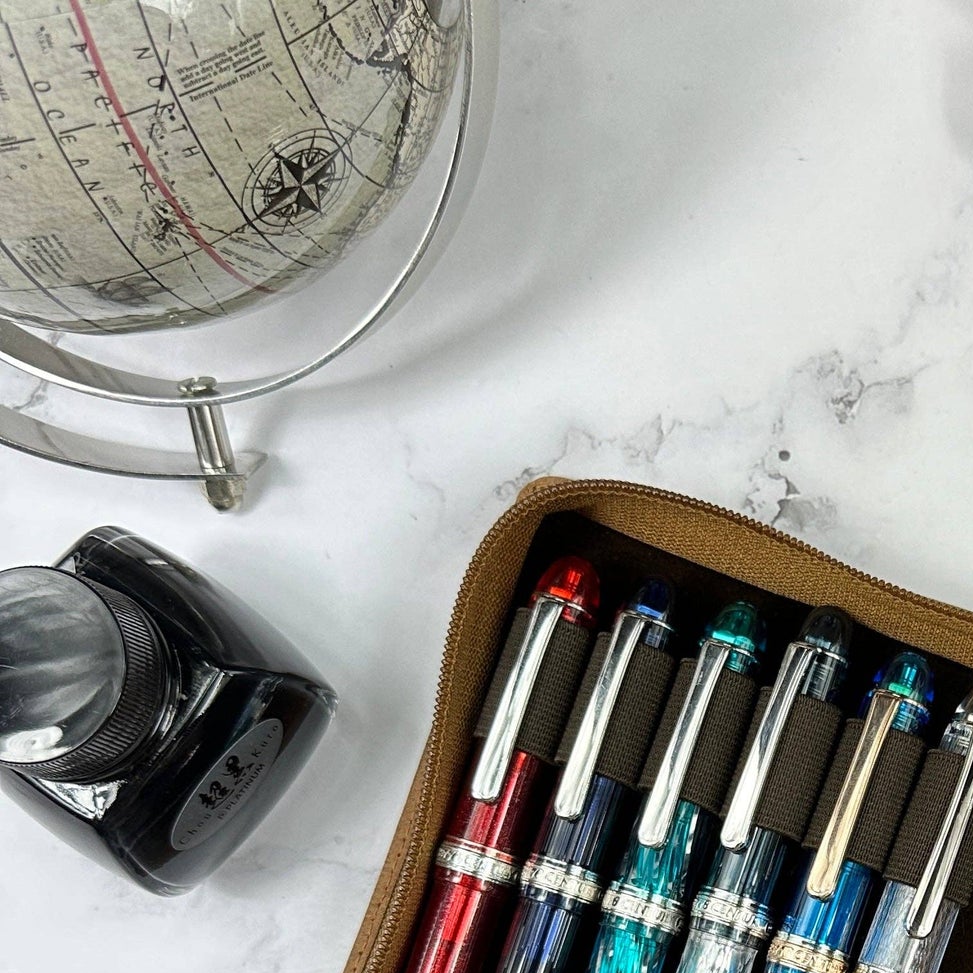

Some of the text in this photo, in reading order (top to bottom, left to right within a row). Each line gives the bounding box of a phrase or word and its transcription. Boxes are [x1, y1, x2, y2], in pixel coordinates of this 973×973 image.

[177, 64, 199, 75] When
[227, 45, 238, 53] the
[239, 38, 253, 47] date
[253, 31, 265, 40] line
[283, 10, 314, 56] ALEUIAN
[181, 72, 194, 82] add
[201, 65, 214, 74] day
[214, 56, 234, 68] going
[234, 48, 248, 58] west
[249, 40, 261, 50] and
[183, 74, 213, 88] subtract
[218, 64, 231, 74] day
[232, 55, 251, 68] going
[189, 61, 273, 102] International Date Line
[70, 42, 158, 196] PACIFIC
[132, 47, 202, 158] NORTH
[33, 80, 105, 192] OCEAN
[251, 725, 279, 758] Kuro
[225, 764, 265, 811] PLATINUM
